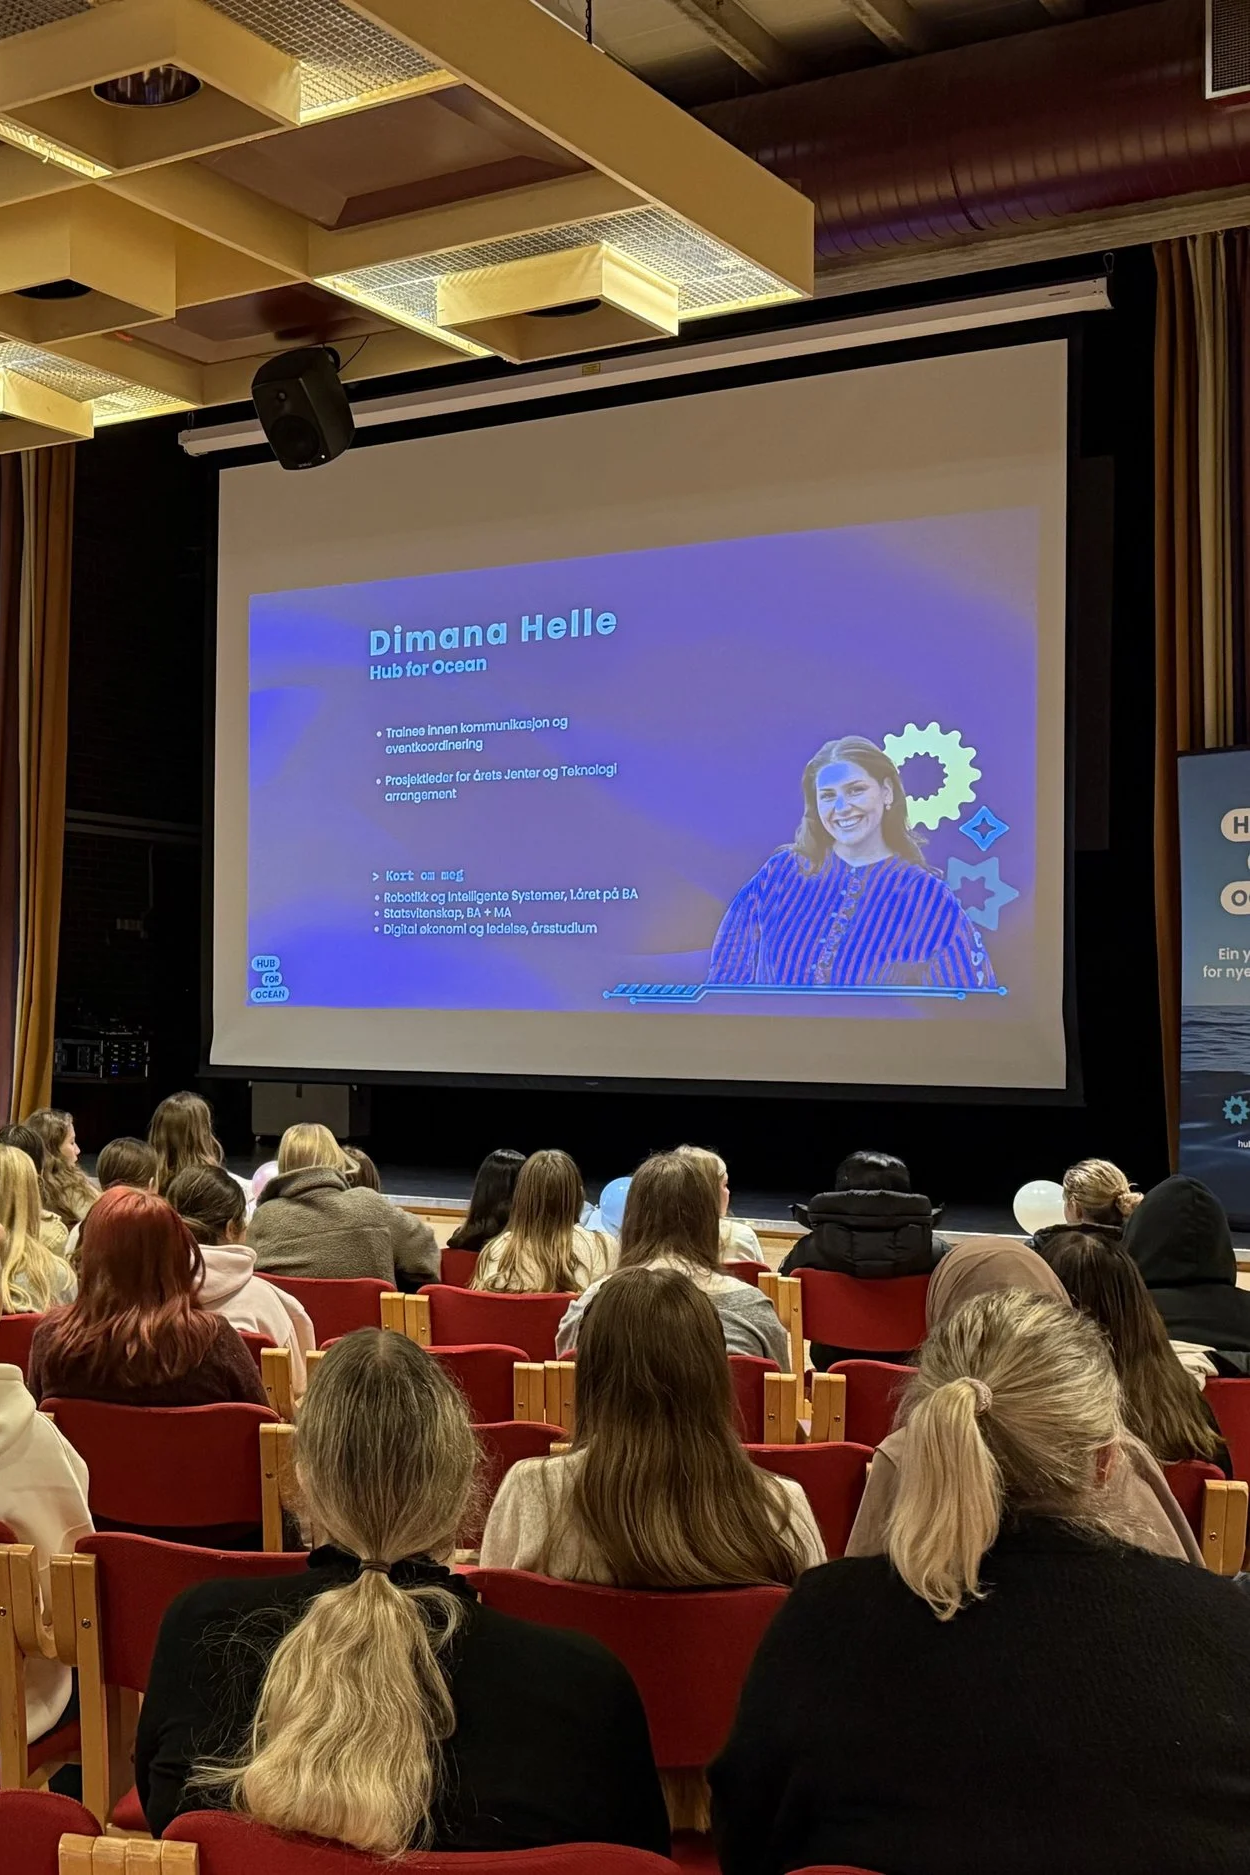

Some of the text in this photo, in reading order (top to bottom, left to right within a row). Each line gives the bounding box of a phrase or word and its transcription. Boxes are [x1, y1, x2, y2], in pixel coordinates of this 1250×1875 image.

[369, 607, 618, 656] Dimana Helle
[369, 656, 488, 680] Hub for Ocean
[385, 716, 569, 739] Trainee innen kommunikasjon og
[385, 738, 484, 754] eventkoordinering
[385, 762, 618, 788] Prosjektleder for årets Jenter og Teknologi
[384, 788, 458, 804] arrangement
[385, 870, 415, 882] Kort
[420, 871, 436, 881] om
[440, 869, 465, 883] meg
[383, 886, 639, 906] Robotikk og Intelligente Systemer, 1.året på BA
[383, 907, 465, 921] Statsvitenskap,
[466, 907, 481, 918] BA
[493, 906, 512, 918] MA
[383, 921, 598, 938] Digital økonomi og ledelse, årsstudium
[1218, 947, 1240, 961] Ein
[256, 959, 275, 968] HUB
[1203, 964, 1223, 978] for
[264, 975, 280, 983] FOR
[255, 990, 285, 999] OCEAN
